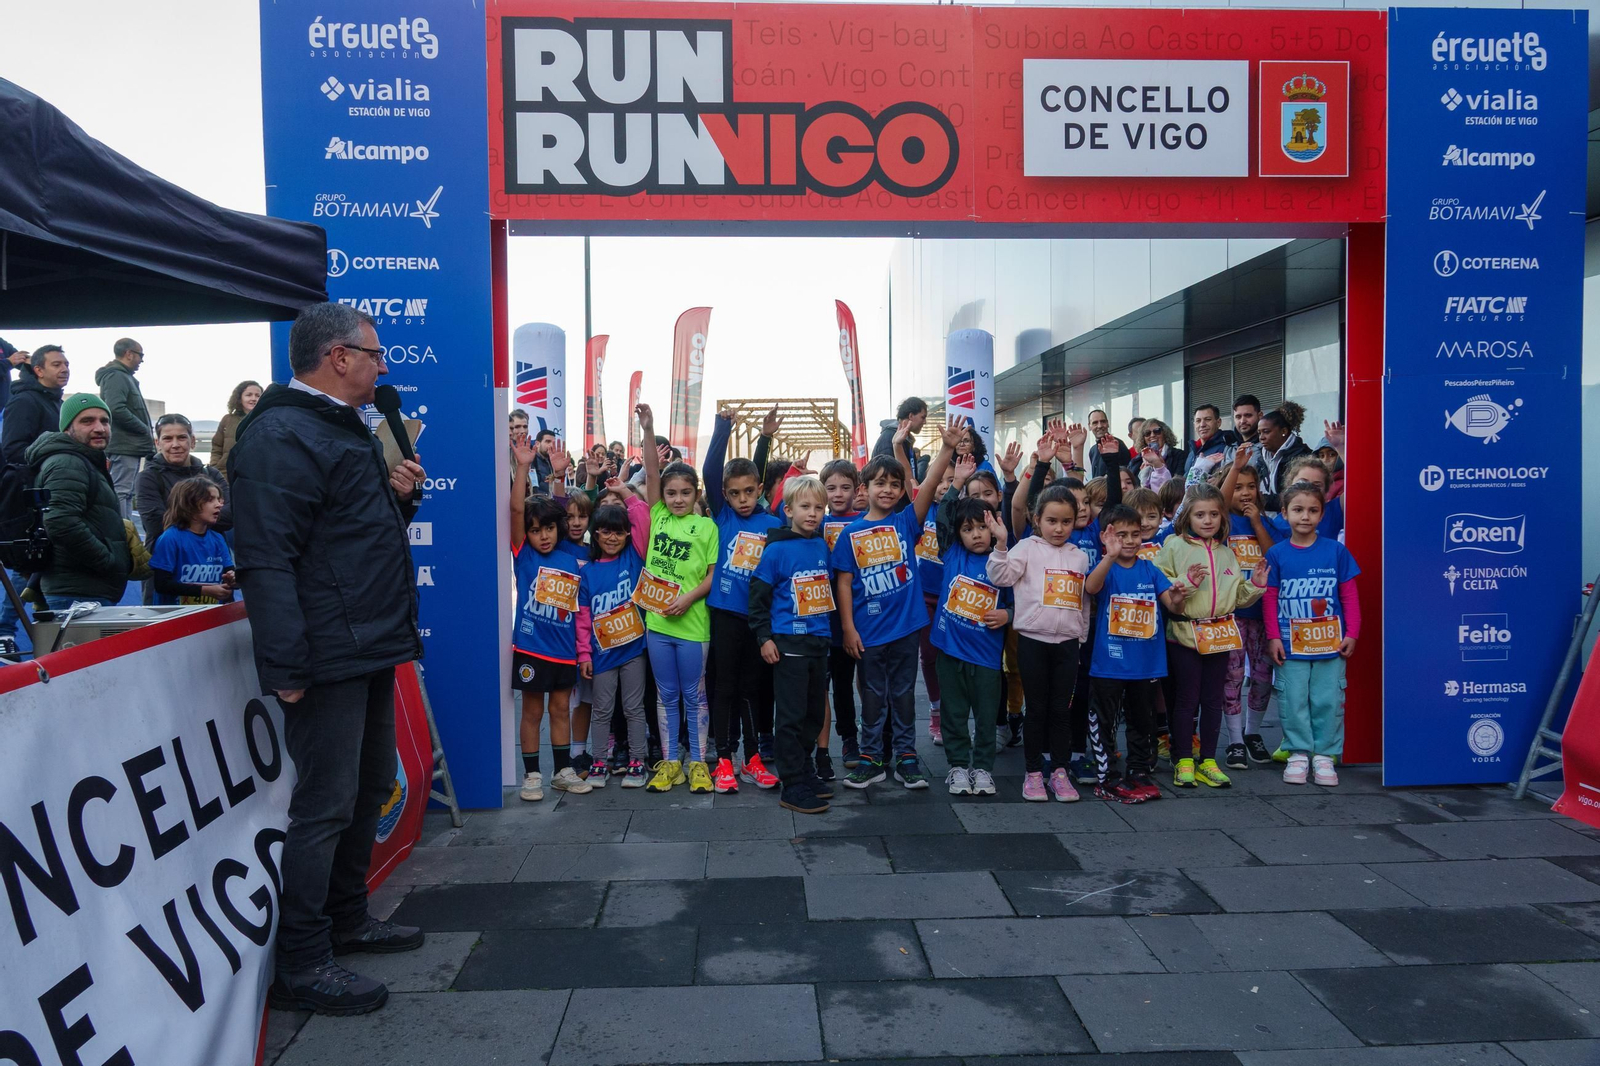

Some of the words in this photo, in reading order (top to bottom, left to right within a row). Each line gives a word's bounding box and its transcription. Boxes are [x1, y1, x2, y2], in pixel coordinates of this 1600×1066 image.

[744, 20, 801, 45] Teis
[829, 20, 949, 53] Vig-bay
[985, 24, 1088, 51] Subida
[1100, 26, 1136, 51] Ao
[1148, 25, 1244, 52] Castro
[1270, 26, 1325, 51] 5+5
[1335, 27, 1371, 52] Do
[514, 28, 725, 104] RUN
[822, 62, 887, 93] Vigo
[349, 78, 431, 102] vialia
[1040, 85, 1230, 114] CONCELLO
[1466, 88, 1538, 111] vialia
[348, 106, 391, 117] ESTACIÓN
[394, 107, 406, 117] DE
[408, 107, 431, 118] VIGO
[1465, 115, 1503, 126] ESTACIÓN
[1505, 116, 1516, 126] DE
[1518, 116, 1538, 126] VIGO
[1064, 122, 1109, 150] DE
[1122, 122, 1209, 151] VIGO
[325, 136, 430, 164] Alcampo
[1442, 145, 1536, 169] Alcampo
[315, 193, 347, 202] GRUPO
[987, 184, 1087, 211] Cáncer
[1118, 187, 1181, 217] Vigo
[1264, 187, 1293, 212] La
[1432, 198, 1460, 206] GRUPO
[312, 202, 410, 218] BOTAMAVI
[1429, 206, 1515, 220] BOTAMAVI
[352, 257, 440, 270] COTERENA
[1462, 257, 1540, 270] COTERENA
[1444, 297, 1505, 314] FIATC
[1436, 341, 1534, 358] MAROSA
[1447, 467, 1549, 480] TECHNOLOGY
[865, 535, 895, 553] 3021
[1463, 565, 1528, 579] FUNDACIÓN
[547, 579, 578, 598] 3037
[641, 581, 674, 605] 3002
[805, 583, 830, 601] 3035
[1278, 577, 1338, 599] CORRER
[1463, 579, 1498, 591] CELTA
[957, 587, 993, 610] 3029
[605, 612, 635, 635] 3017
[1119, 607, 1151, 625] 3030
[1303, 625, 1335, 641] 3018
[1458, 623, 1512, 643] Feito
[1463, 681, 1527, 694] Hermasa
[0, 698, 282, 947] NCELLO
